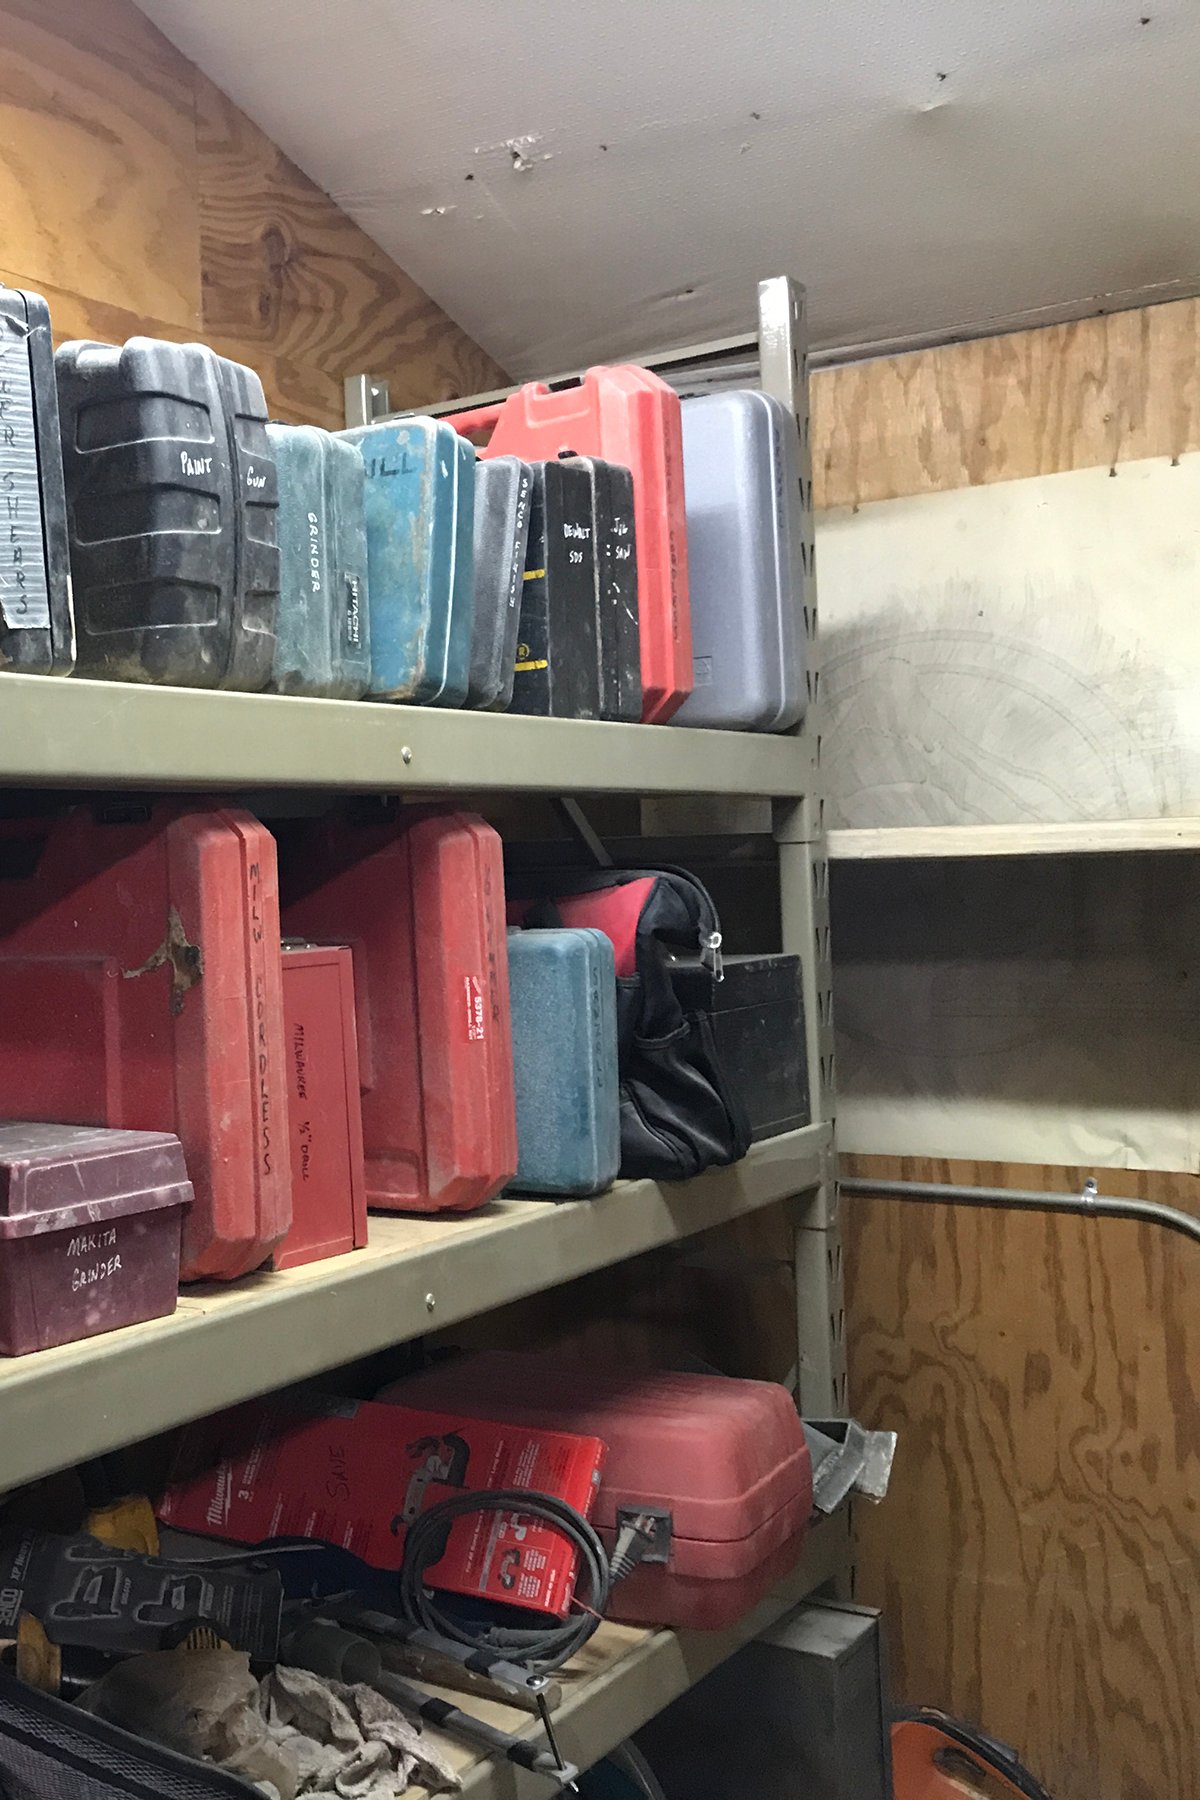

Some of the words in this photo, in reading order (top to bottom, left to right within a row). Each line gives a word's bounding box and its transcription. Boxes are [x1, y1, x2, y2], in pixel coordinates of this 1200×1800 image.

[180, 450, 213, 476] PAINT
[516, 478, 529, 529] SENCO
[2, 470, 28, 616] SHEARS
[307, 511, 321, 593] GRINDER
[569, 550, 583, 564] SDS
[615, 544, 632, 560] SAW
[350, 580, 360, 643] HITACHI
[250, 862, 263, 943] MILW
[255, 976, 273, 1176] CORDLESS
[66, 1227, 117, 1257] MAKITA
[71, 1253, 123, 1292] GRINDER
[238, 1489, 250, 1501] 3
[326, 1445, 351, 1501] SAVE
